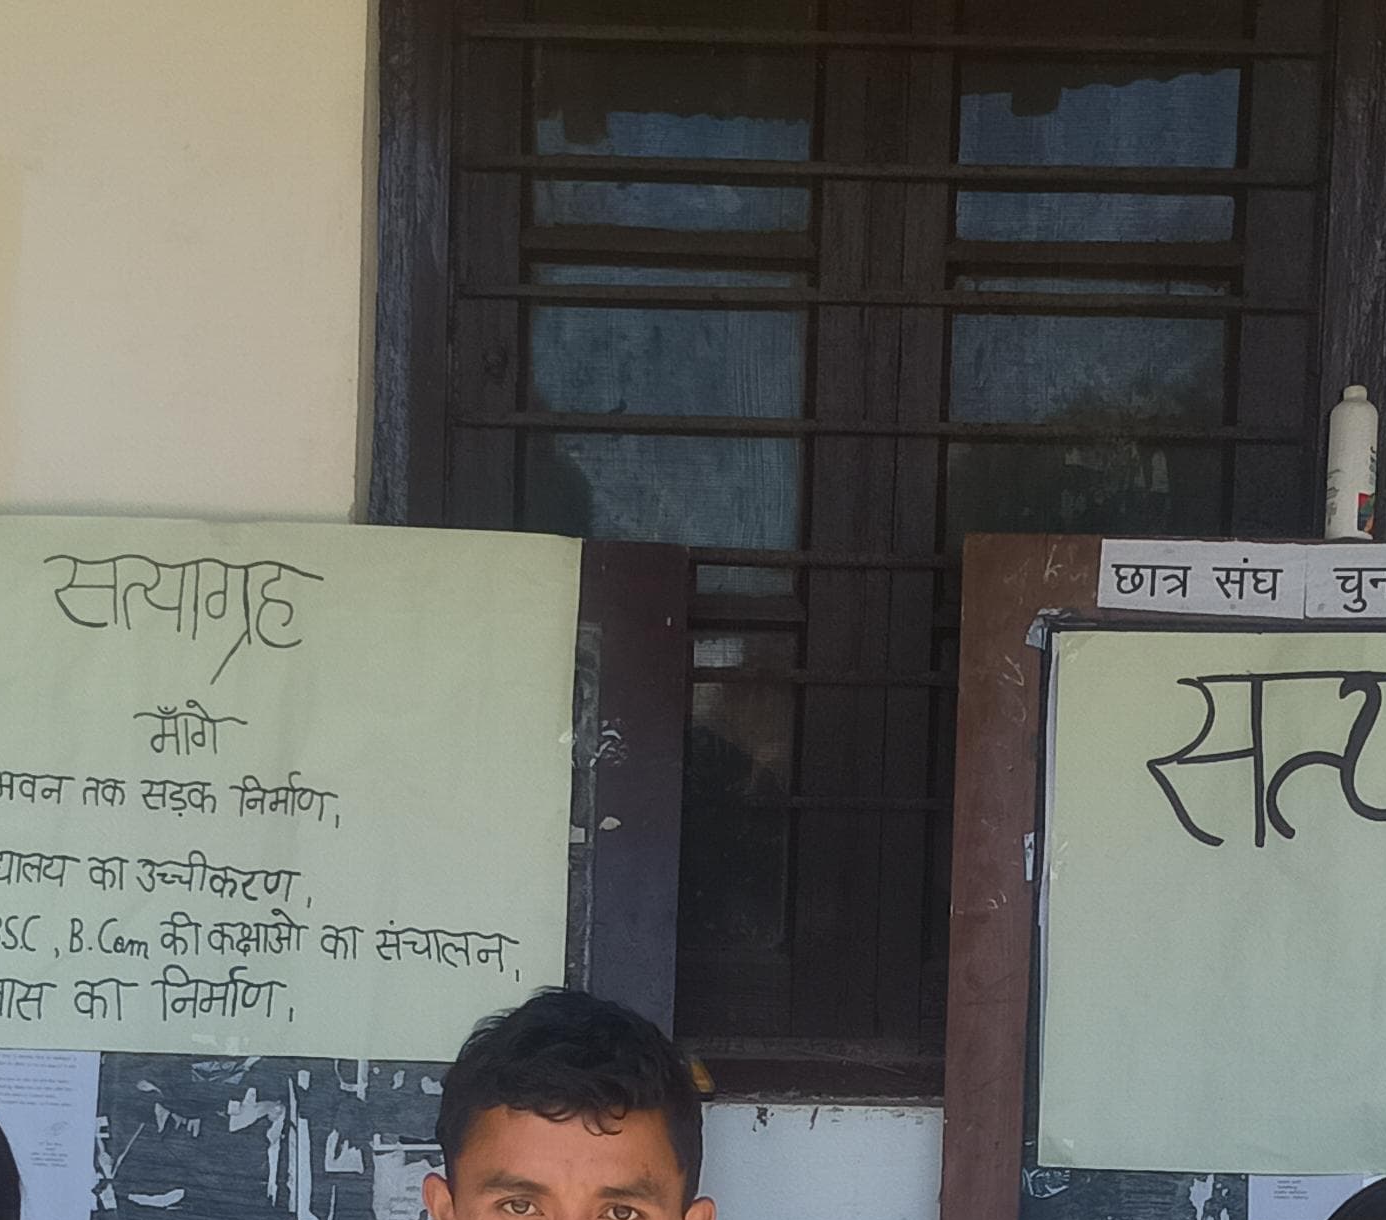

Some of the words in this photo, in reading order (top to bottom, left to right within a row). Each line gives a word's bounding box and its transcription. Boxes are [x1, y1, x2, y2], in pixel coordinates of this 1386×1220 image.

[1112, 563, 1192, 599] छात्र
[1213, 556, 1284, 600] संघ
[44, 553, 324, 685] सत्याग्रह
[83, 776, 126, 807] तक
[141, 779, 216, 817] सड़क
[88, 857, 130, 891] का
[160, 911, 203, 955] की
[321, 924, 365, 960] का
[74, 977, 139, 1021] का
